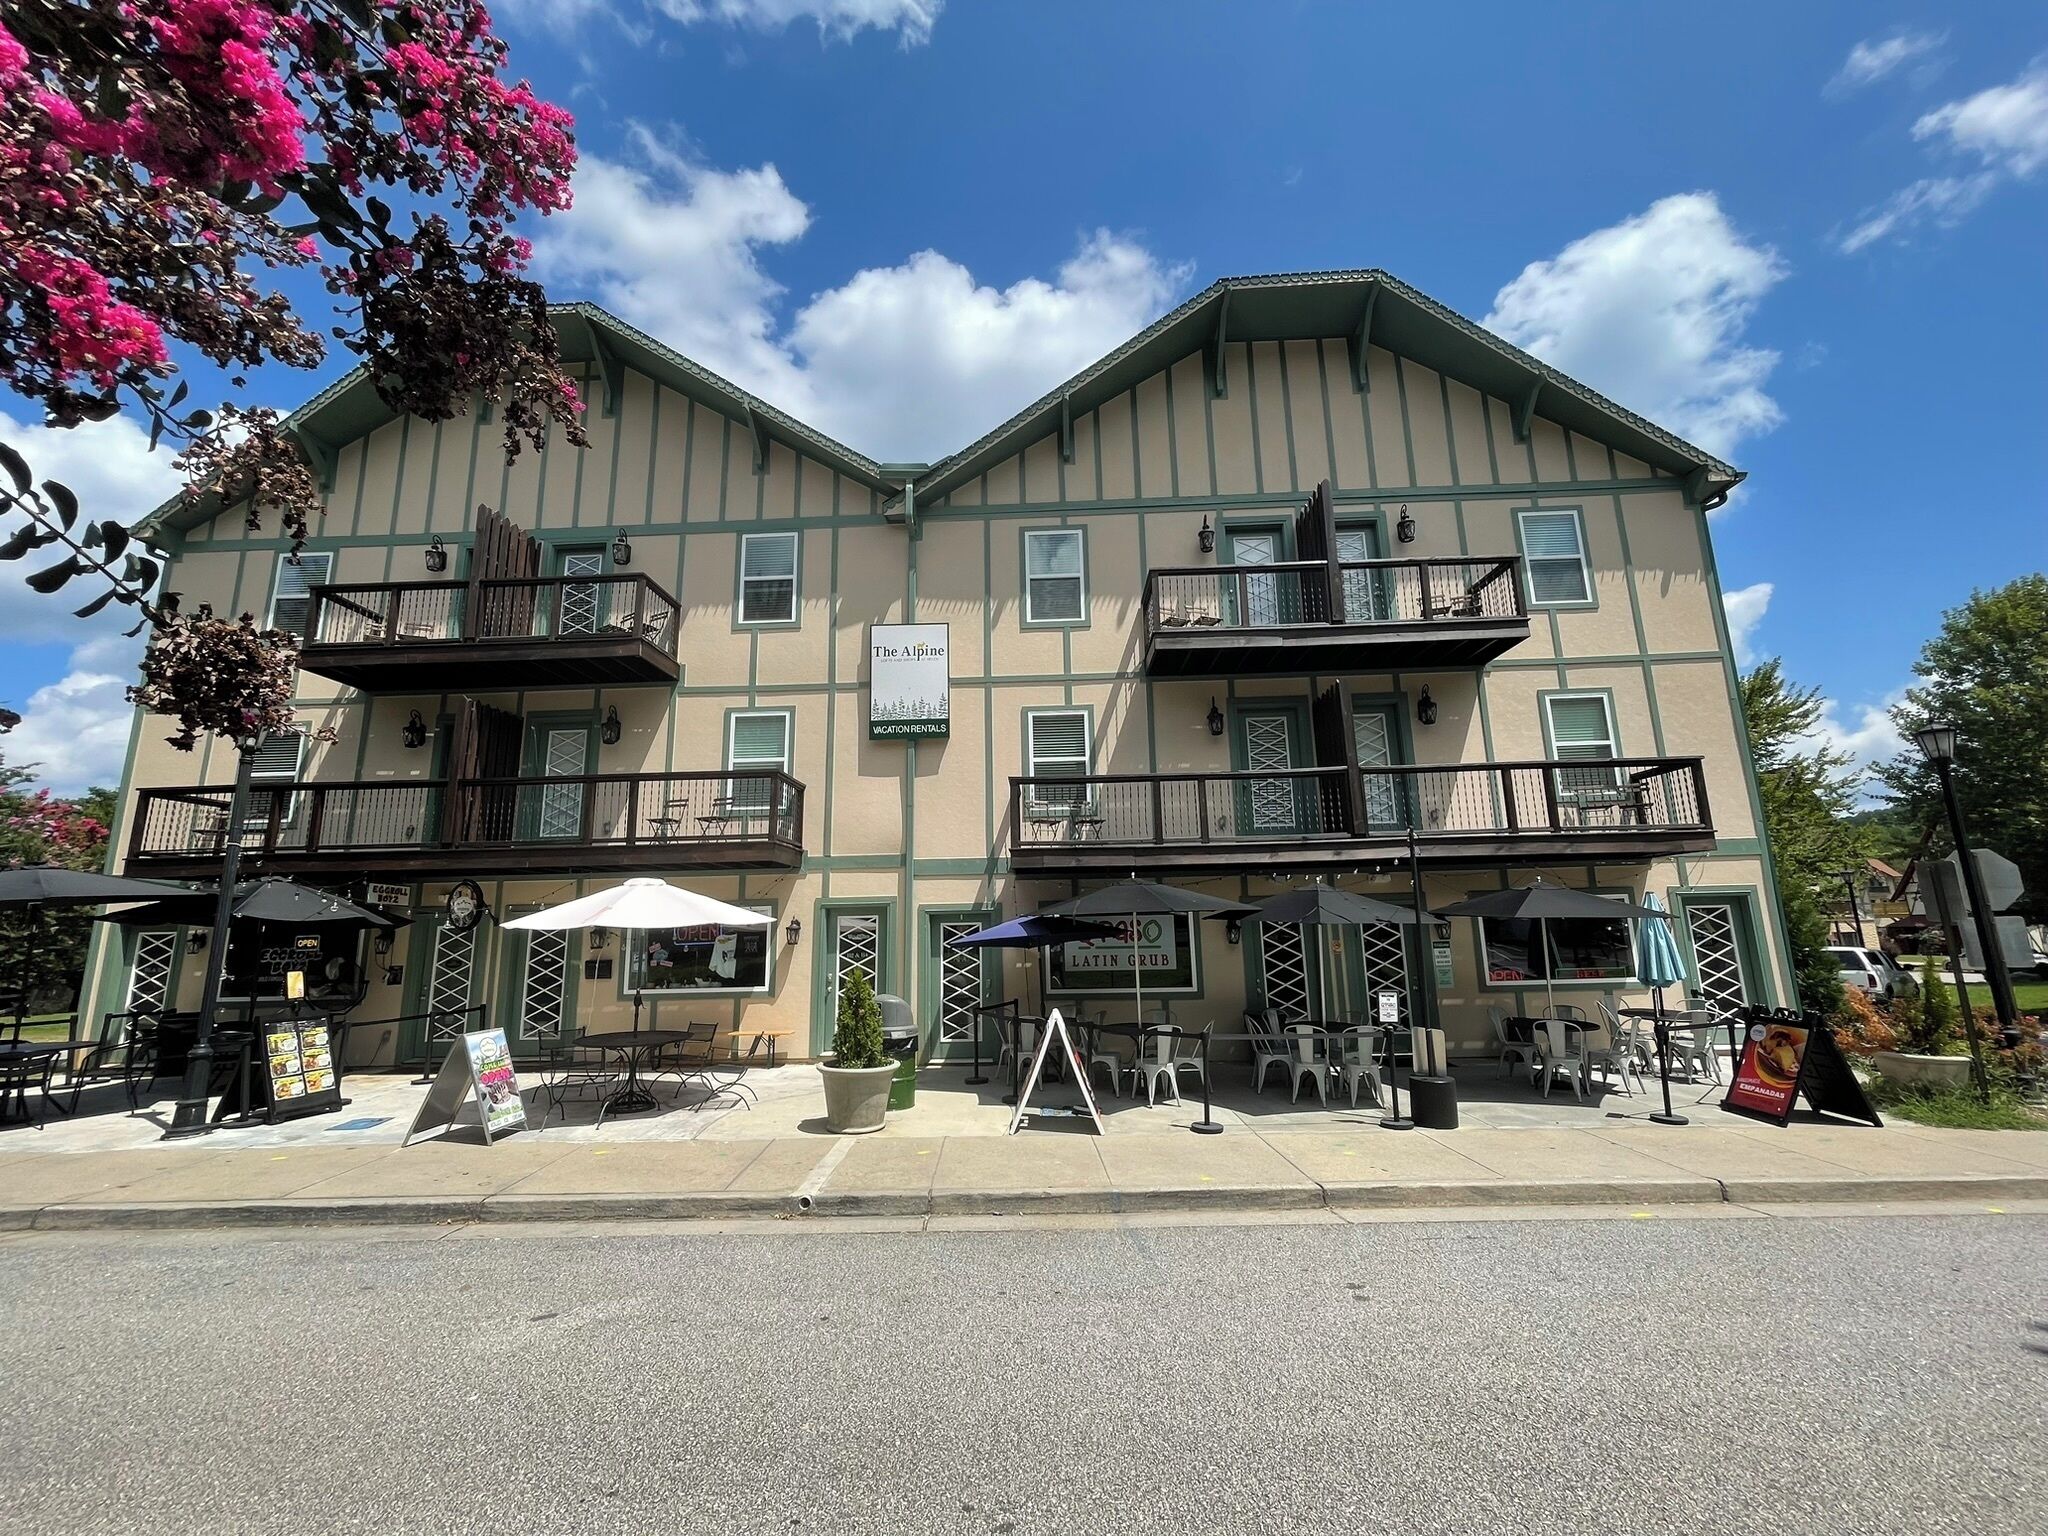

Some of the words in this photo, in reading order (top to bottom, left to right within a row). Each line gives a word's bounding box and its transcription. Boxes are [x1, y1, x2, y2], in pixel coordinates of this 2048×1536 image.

[873, 646, 898, 658] The
[901, 644, 945, 662] Alpine
[873, 725, 910, 734] VACATION
[911, 723, 947, 734] RENTALS
[372, 884, 408, 897] EGGROLL
[677, 923, 720, 941] OPEN
[297, 939, 318, 948] OPEN
[1072, 954, 1119, 967] LATIN
[1127, 954, 1170, 967] GRUB
[480, 1068, 511, 1085] OPEN
[1739, 1083, 1785, 1099] EMPANADAS
